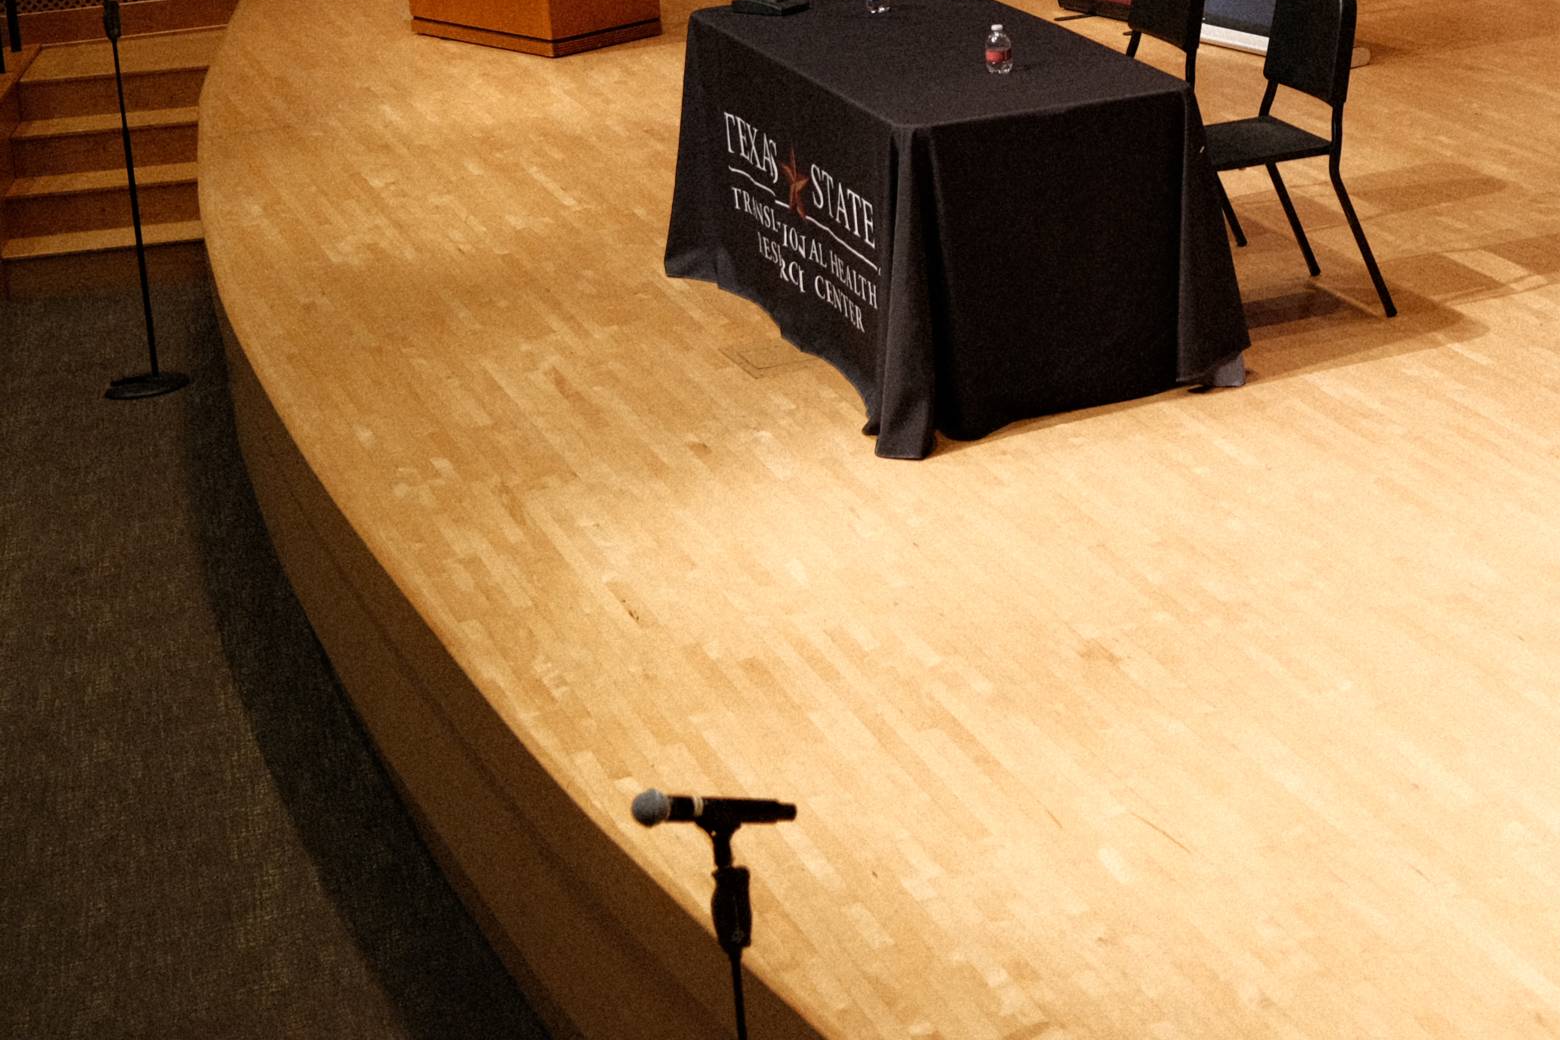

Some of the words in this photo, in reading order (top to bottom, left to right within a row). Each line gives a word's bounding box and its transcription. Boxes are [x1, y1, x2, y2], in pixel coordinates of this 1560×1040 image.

[810, 163, 876, 250] STATE
[814, 275, 866, 333] CENTER
[829, 250, 878, 311] HEALTH
